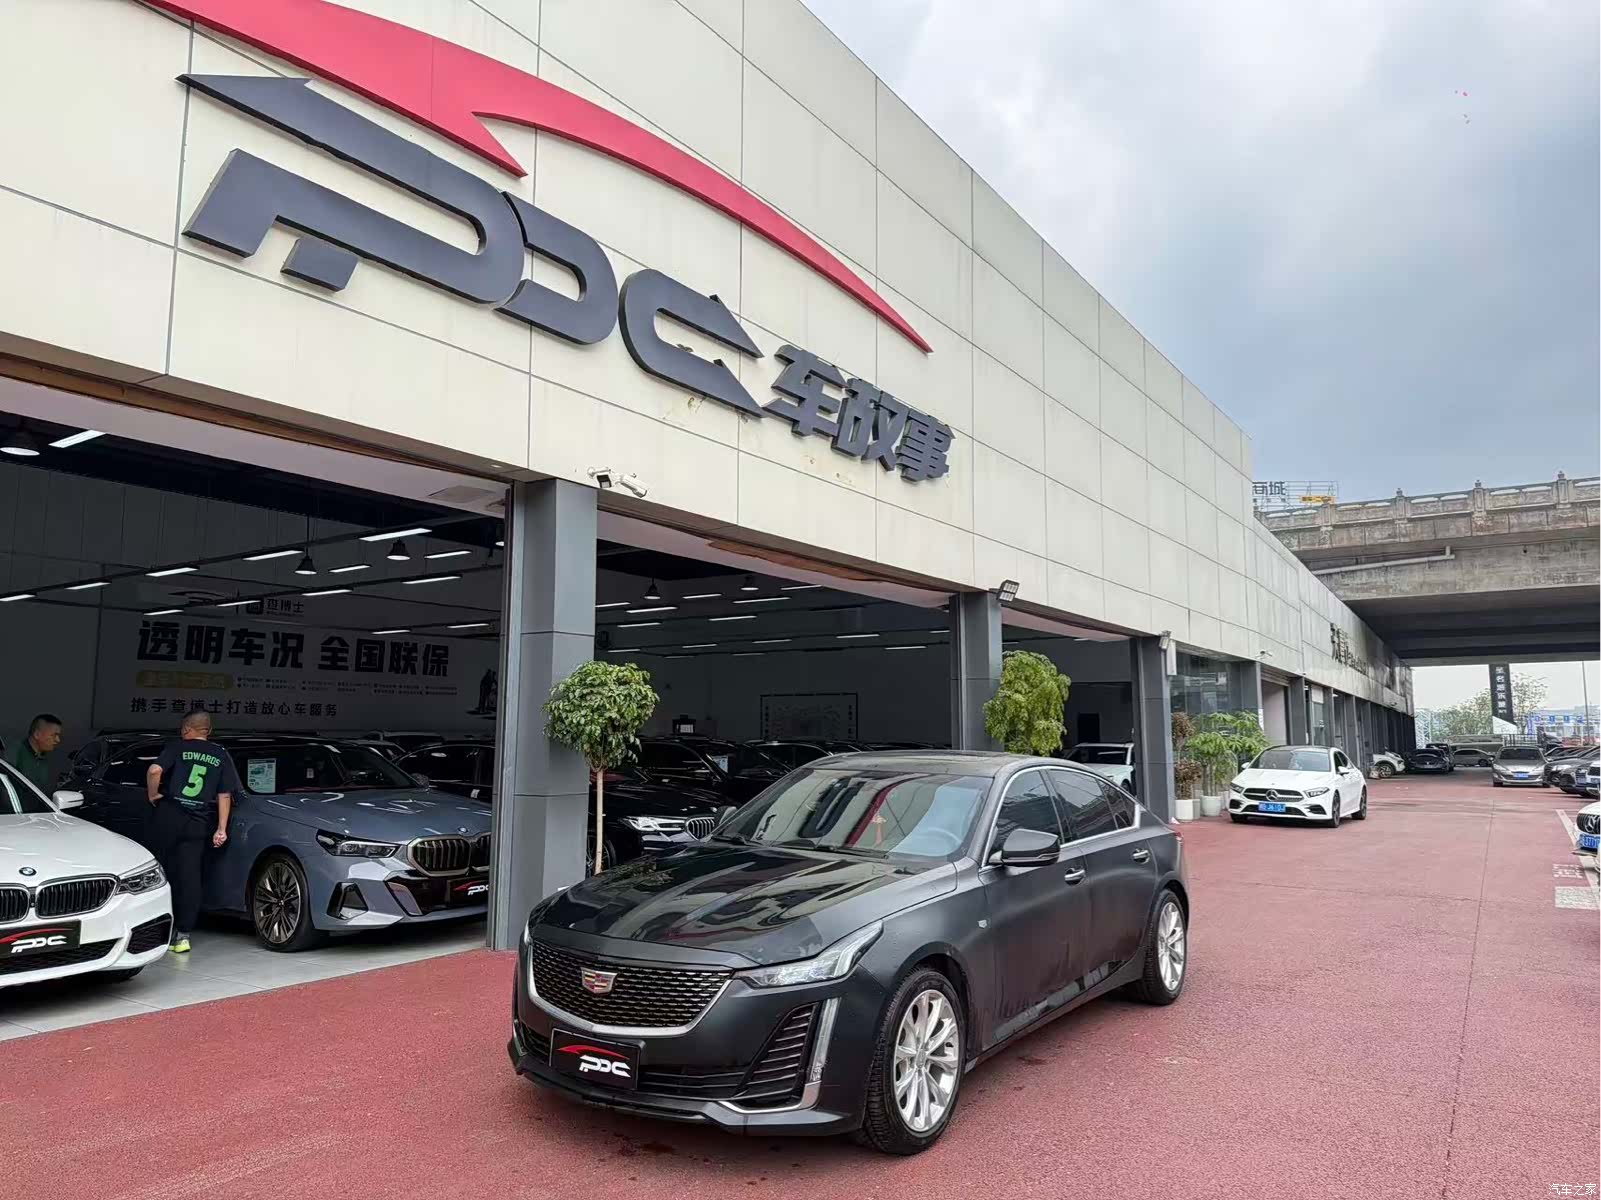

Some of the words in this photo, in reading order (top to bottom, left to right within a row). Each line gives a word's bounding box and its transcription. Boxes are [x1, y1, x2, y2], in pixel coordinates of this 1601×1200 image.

[175, 73, 765, 418] PDC
[761, 343, 956, 482] 车故事
[137, 620, 305, 669] 透明车况
[318, 636, 449, 677] 全国联保
[131, 696, 338, 718] 携手查博士打造放心车服务
[182, 751, 221, 767] EDWARDS
[181, 763, 207, 798] 5
[11, 935, 67, 953] PDC
[579, 1054, 631, 1078] PDC
